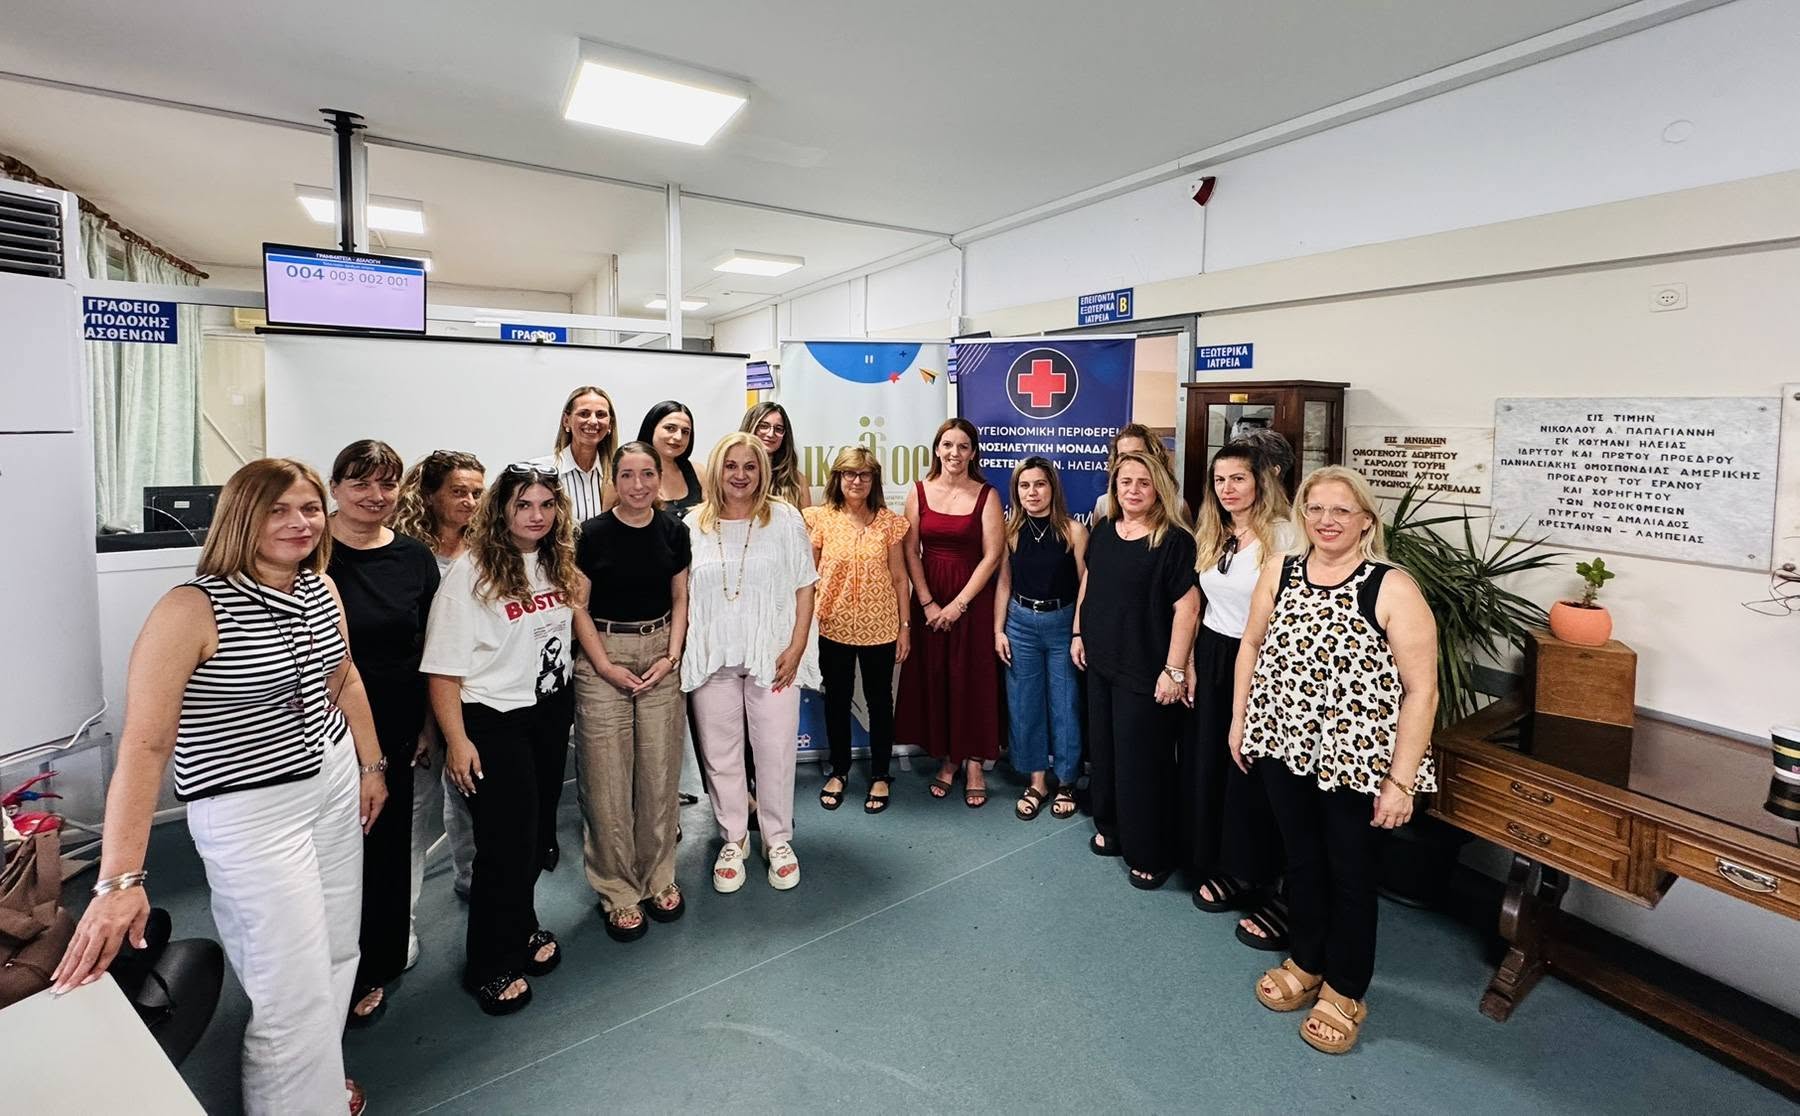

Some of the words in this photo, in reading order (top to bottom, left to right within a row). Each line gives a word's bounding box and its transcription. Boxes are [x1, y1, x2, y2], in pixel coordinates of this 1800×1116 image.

[286, 265, 324, 280] 004
[329, 270, 354, 282] 003
[359, 273, 383, 284] 002
[387, 276, 408, 287] 001
[1080, 292, 1115, 305] ΕΠΕΙΓΟΝΤΑ
[88, 299, 160, 314] ΓΡΑΦΕΙΟ
[1080, 302, 1115, 315] ΕΞΩΤΕΡΙΚΑ
[84, 313, 170, 328] ΥΠΟΔΟΧΗΣ
[1085, 313, 1109, 324] ΙΑΤΡΕΙΑ
[85, 327, 165, 341] ΑΣΘΕΝΩΝ
[1200, 346, 1249, 358] ΕΞΩΤΕΡΙΚΑ
[1207, 357, 1241, 368] ΙΑΤΡΕΙΑ
[1587, 414, 1604, 422] ΕΙΣ
[1613, 414, 1655, 422] ΤΙΜΗΝ
[978, 426, 1055, 437] ΥΓΕΙΟΝΟΜΙΚΗ
[1058, 427, 1119, 438] ΠΕΡΙΦΕΡΕΙ
[1540, 425, 1596, 434] ΝΙΚΟΛΑΟΥ
[1626, 427, 1715, 437] ΠΑΠΑΓΙΑΝΝΗ
[1384, 436, 1397, 444] ΕΙΣ
[1404, 436, 1447, 445] ΜΝΗΜΗΝ
[1578, 438, 1630, 447] ΚΟΥΜΑΝΙ
[1639, 440, 1686, 449] ΗΛΕΙΑΣ
[978, 442, 1053, 453] ΝΟΣΗΛΕΥΤΙΚΗ
[1056, 443, 1109, 454] ΜΟΝΑΔΑ
[1353, 449, 1407, 457] ΟΜΟΓΕΝΟΥΣ
[1411, 451, 1458, 460] ΔΩΡΗΤΟΥ
[1518, 448, 1563, 456] ΙΔΡΥΤΟΥ
[1571, 450, 1592, 458] ΚΑΙ
[1602, 451, 1649, 460] ΠΡΩΤΟΥ
[1660, 454, 1734, 464] ΠΡΟΕΔΡΟΥ
[1053, 461, 1064, 470] Ν.
[1068, 461, 1110, 471] ΗΛΕΙΑΣ
[1364, 459, 1408, 468] ΚΑΡΟΛΟΥ
[1412, 461, 1445, 470] ΤΟΥΡΗ
[1501, 459, 1576, 469] ΠΑΝΗΛΕΙΑΚΗΣ
[1584, 463, 1669, 475] ΟΜΟΣΠΟΝΔΙΑΣ
[1680, 468, 1760, 480] ΑΜΕΡΙΚΗΣ
[1353, 468, 1366, 476] ΑΙ
[1372, 469, 1408, 478] ΓΟΝΕΩΝ
[1547, 473, 1607, 484] ΠΡΟΕΔΡΟΥ
[1618, 477, 1641, 486] ΤΟΥ
[1651, 479, 1702, 490] ΕΡΑΝΟΥ
[1427, 483, 1481, 494] ΚΑΝΕΛΛΑΣ
[1563, 486, 1582, 494] ΚΑΙ
[1592, 488, 1671, 501] ΧΟΡΗΓΗΤΟΥ
[1557, 497, 1583, 506] ΤΩΝ
[1593, 501, 1685, 516] ΝΟΣΟΚΟΜΕΙΩΝ
[1548, 508, 1594, 519] ΠΥΡΓΟΥ
[1617, 515, 1690, 529] ΑΜΑΛΙΑΔΟΣ
[1538, 519, 1612, 533] ΚΡΕΣΤΑΙΝΩΝ
[1636, 530, 1704, 544] ΛΑΜΠΕΙΑΣ
[504, 590, 567, 620] BOSTO
